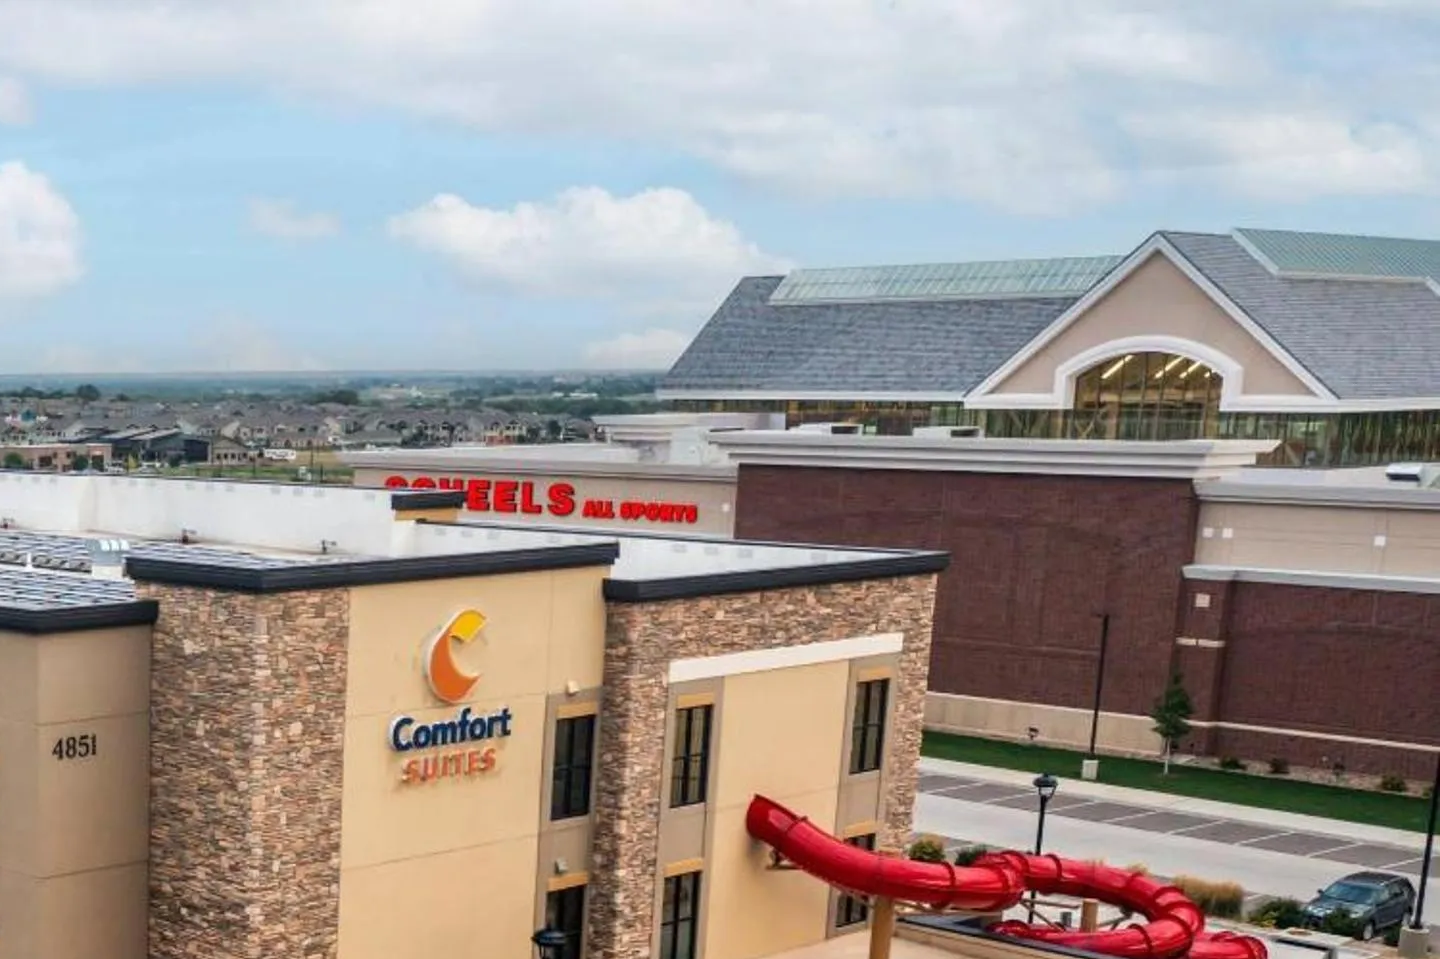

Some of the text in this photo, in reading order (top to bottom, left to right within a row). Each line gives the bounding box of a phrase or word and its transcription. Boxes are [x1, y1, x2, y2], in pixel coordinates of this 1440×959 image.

[582, 500, 615, 519] ALL
[620, 501, 698, 524] SPORTS
[391, 706, 512, 751] Comfort
[51, 733, 97, 761] 4851
[402, 747, 496, 783] SUITES
